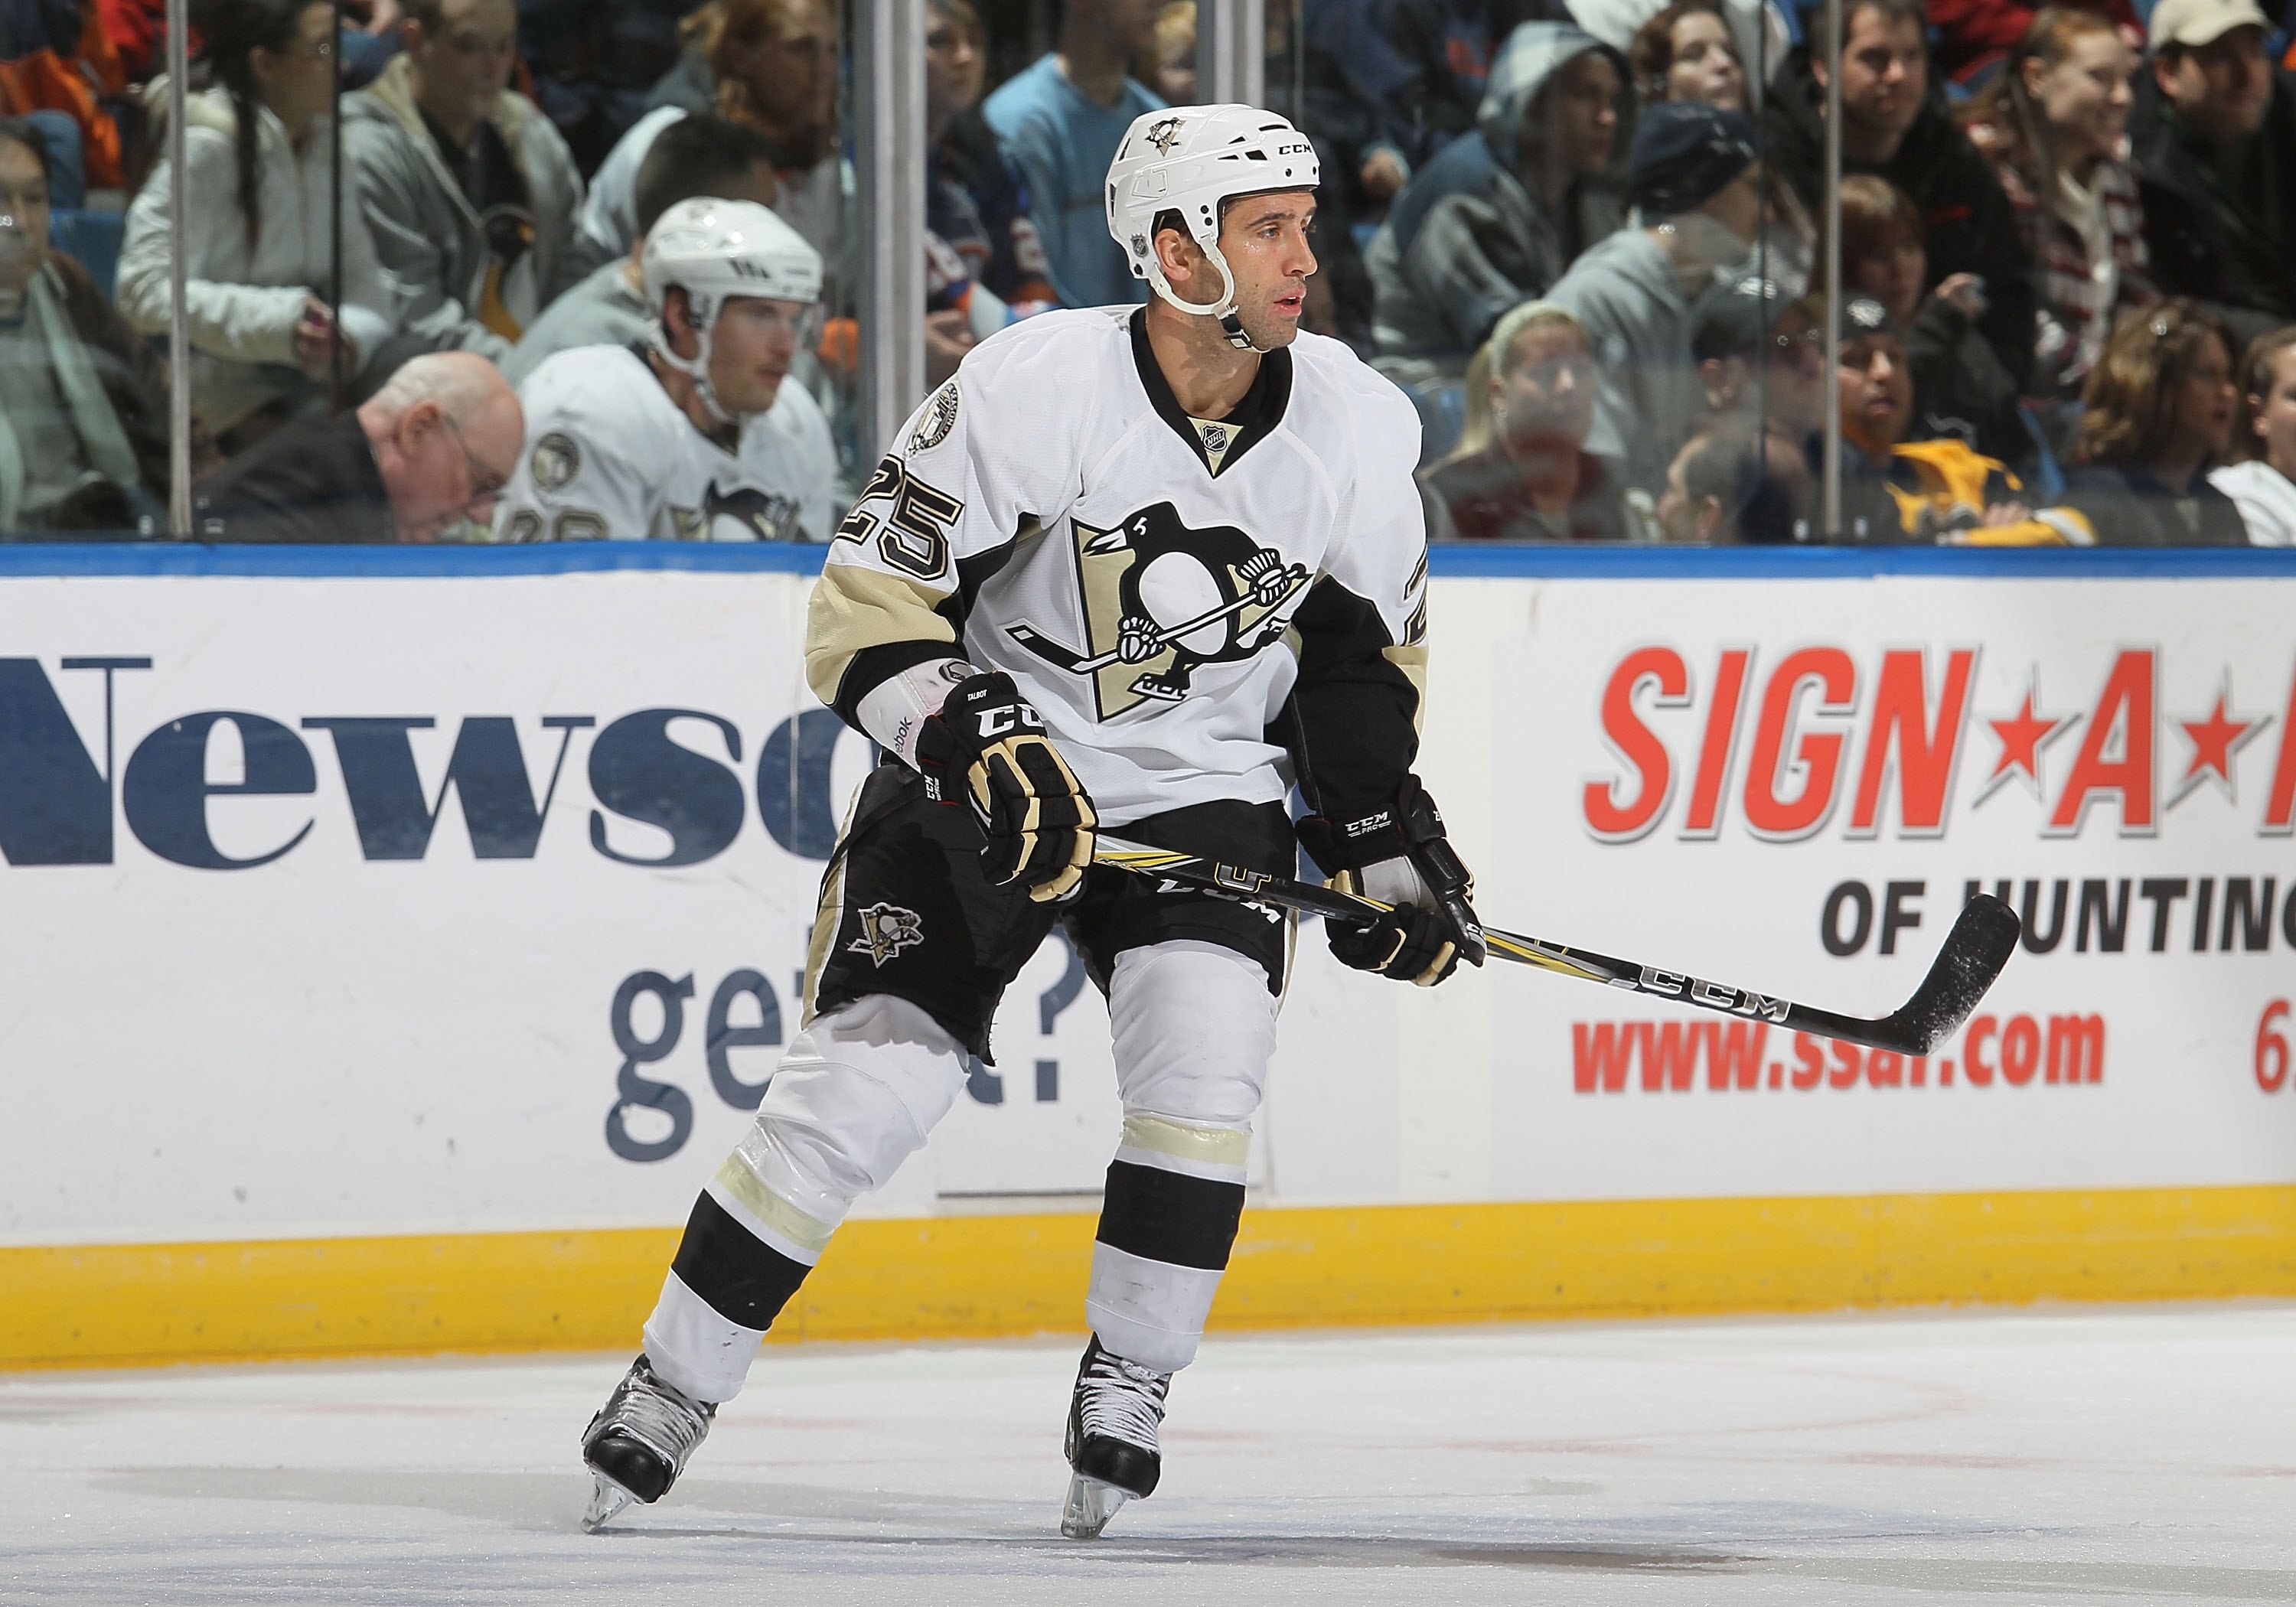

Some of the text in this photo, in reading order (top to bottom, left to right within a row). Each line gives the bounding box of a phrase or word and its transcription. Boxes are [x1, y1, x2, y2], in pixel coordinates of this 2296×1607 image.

[1278, 144, 1313, 155] CCM
[1206, 431, 1222, 447] NHL
[833, 454, 965, 581] 25
[967, 689, 988, 702] TALBOT
[893, 716, 912, 756] ebok
[1583, 645, 1982, 842] SIGN
[1345, 811, 1388, 832] CCM
[1821, 876, 2296, 957] OF UNTIN
[1639, 965, 1792, 1023] CCM
[2255, 999, 2296, 1093] 6
